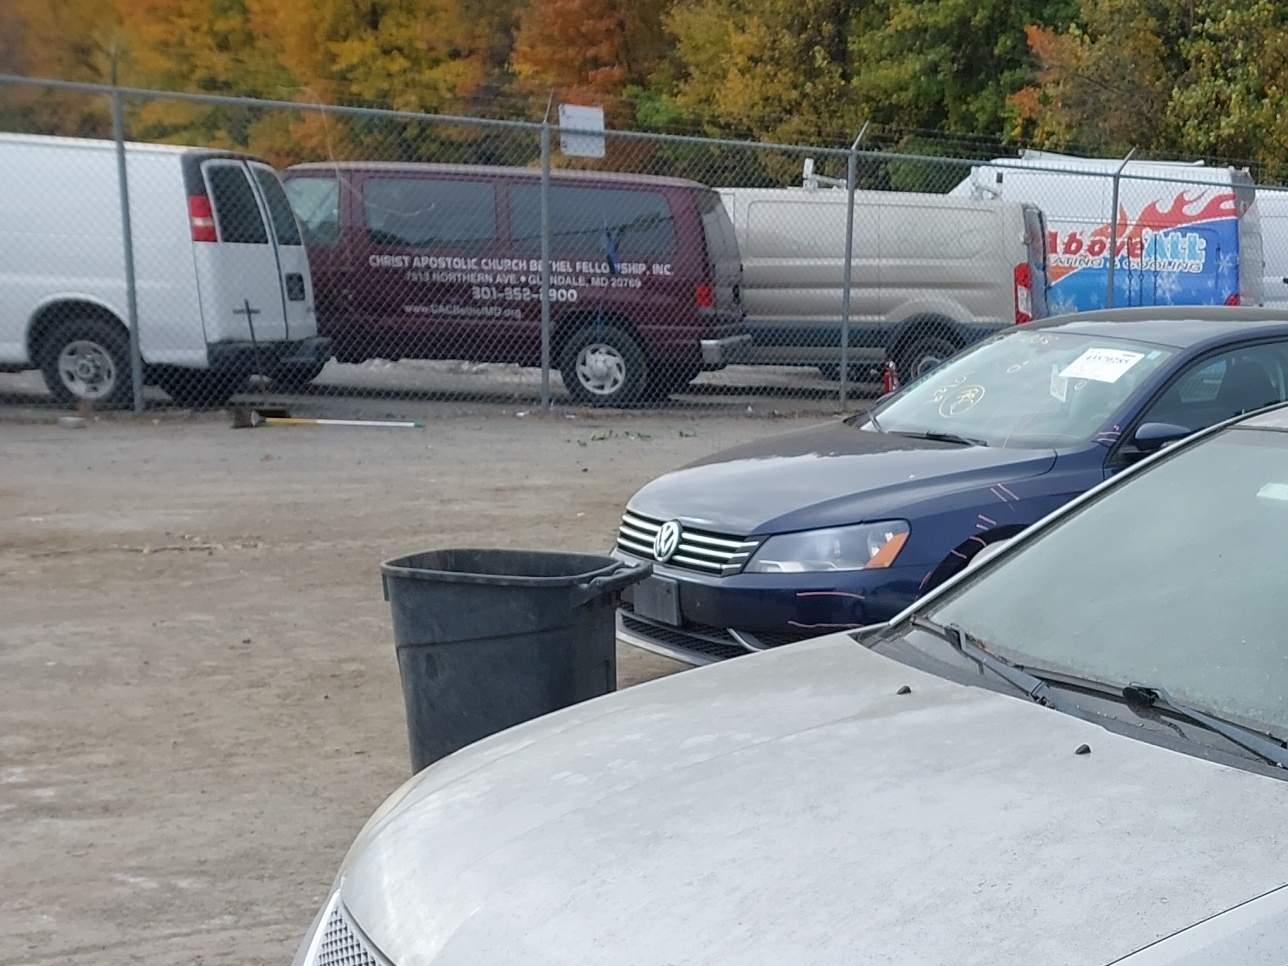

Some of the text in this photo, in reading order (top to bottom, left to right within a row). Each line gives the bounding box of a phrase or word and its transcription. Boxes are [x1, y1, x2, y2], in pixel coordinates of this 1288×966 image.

[369, 254, 411, 268] CHRIST
[413, 256, 478, 270] APOSTOLIC
[481, 258, 527, 272] CHURCH
[575, 261, 650, 276] FELLOSHIP,
[1122, 258, 1204, 273] COOLING
[432, 271, 493, 284] NORTHERN
[528, 274, 589, 287] GLNDALE,
[591, 276, 609, 287] MD
